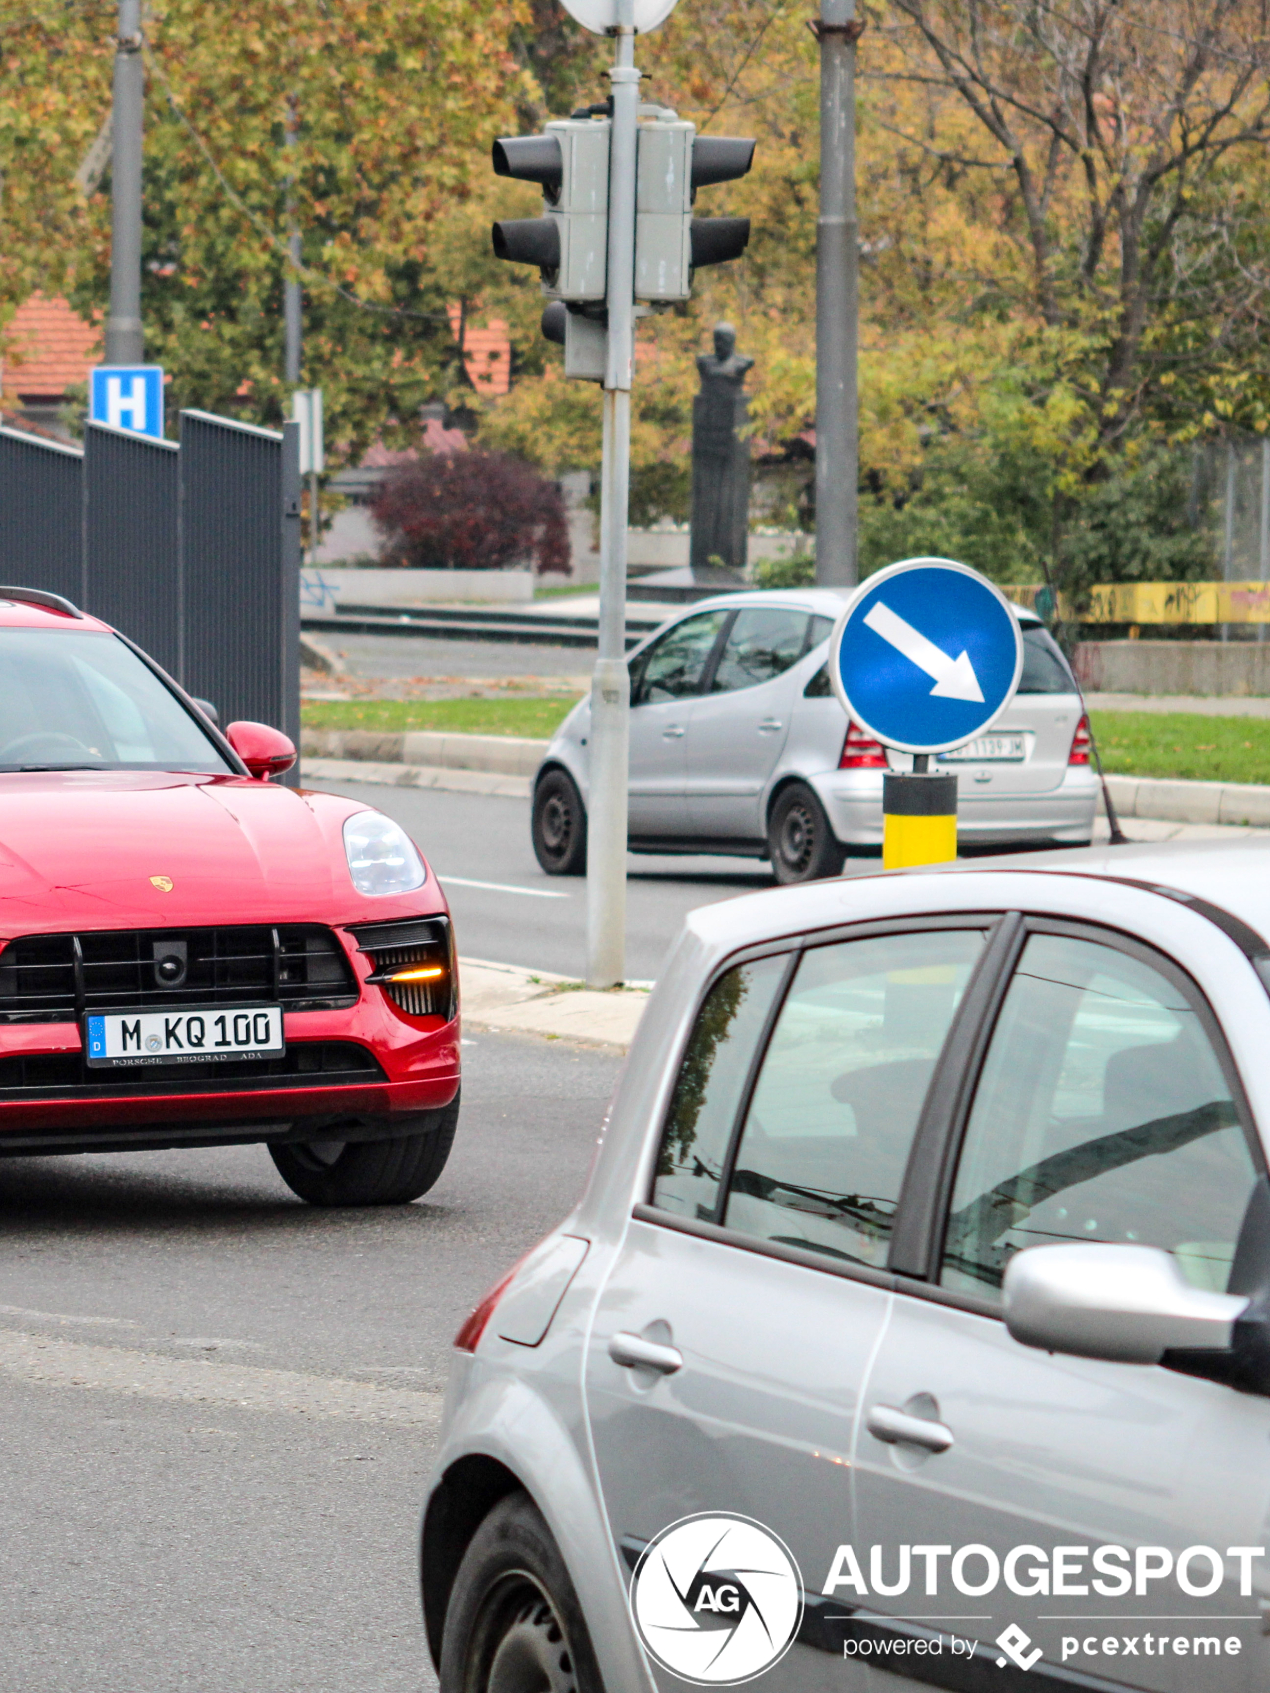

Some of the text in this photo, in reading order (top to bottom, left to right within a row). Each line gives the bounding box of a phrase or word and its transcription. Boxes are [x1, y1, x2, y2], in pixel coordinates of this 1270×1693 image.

[107, 377, 147, 431] H
[121, 1013, 270, 1051] M KQ 100
[93, 1042, 101, 1051] D
[112, 1051, 262, 1067] PORSCHE BEOGRAD ADA
